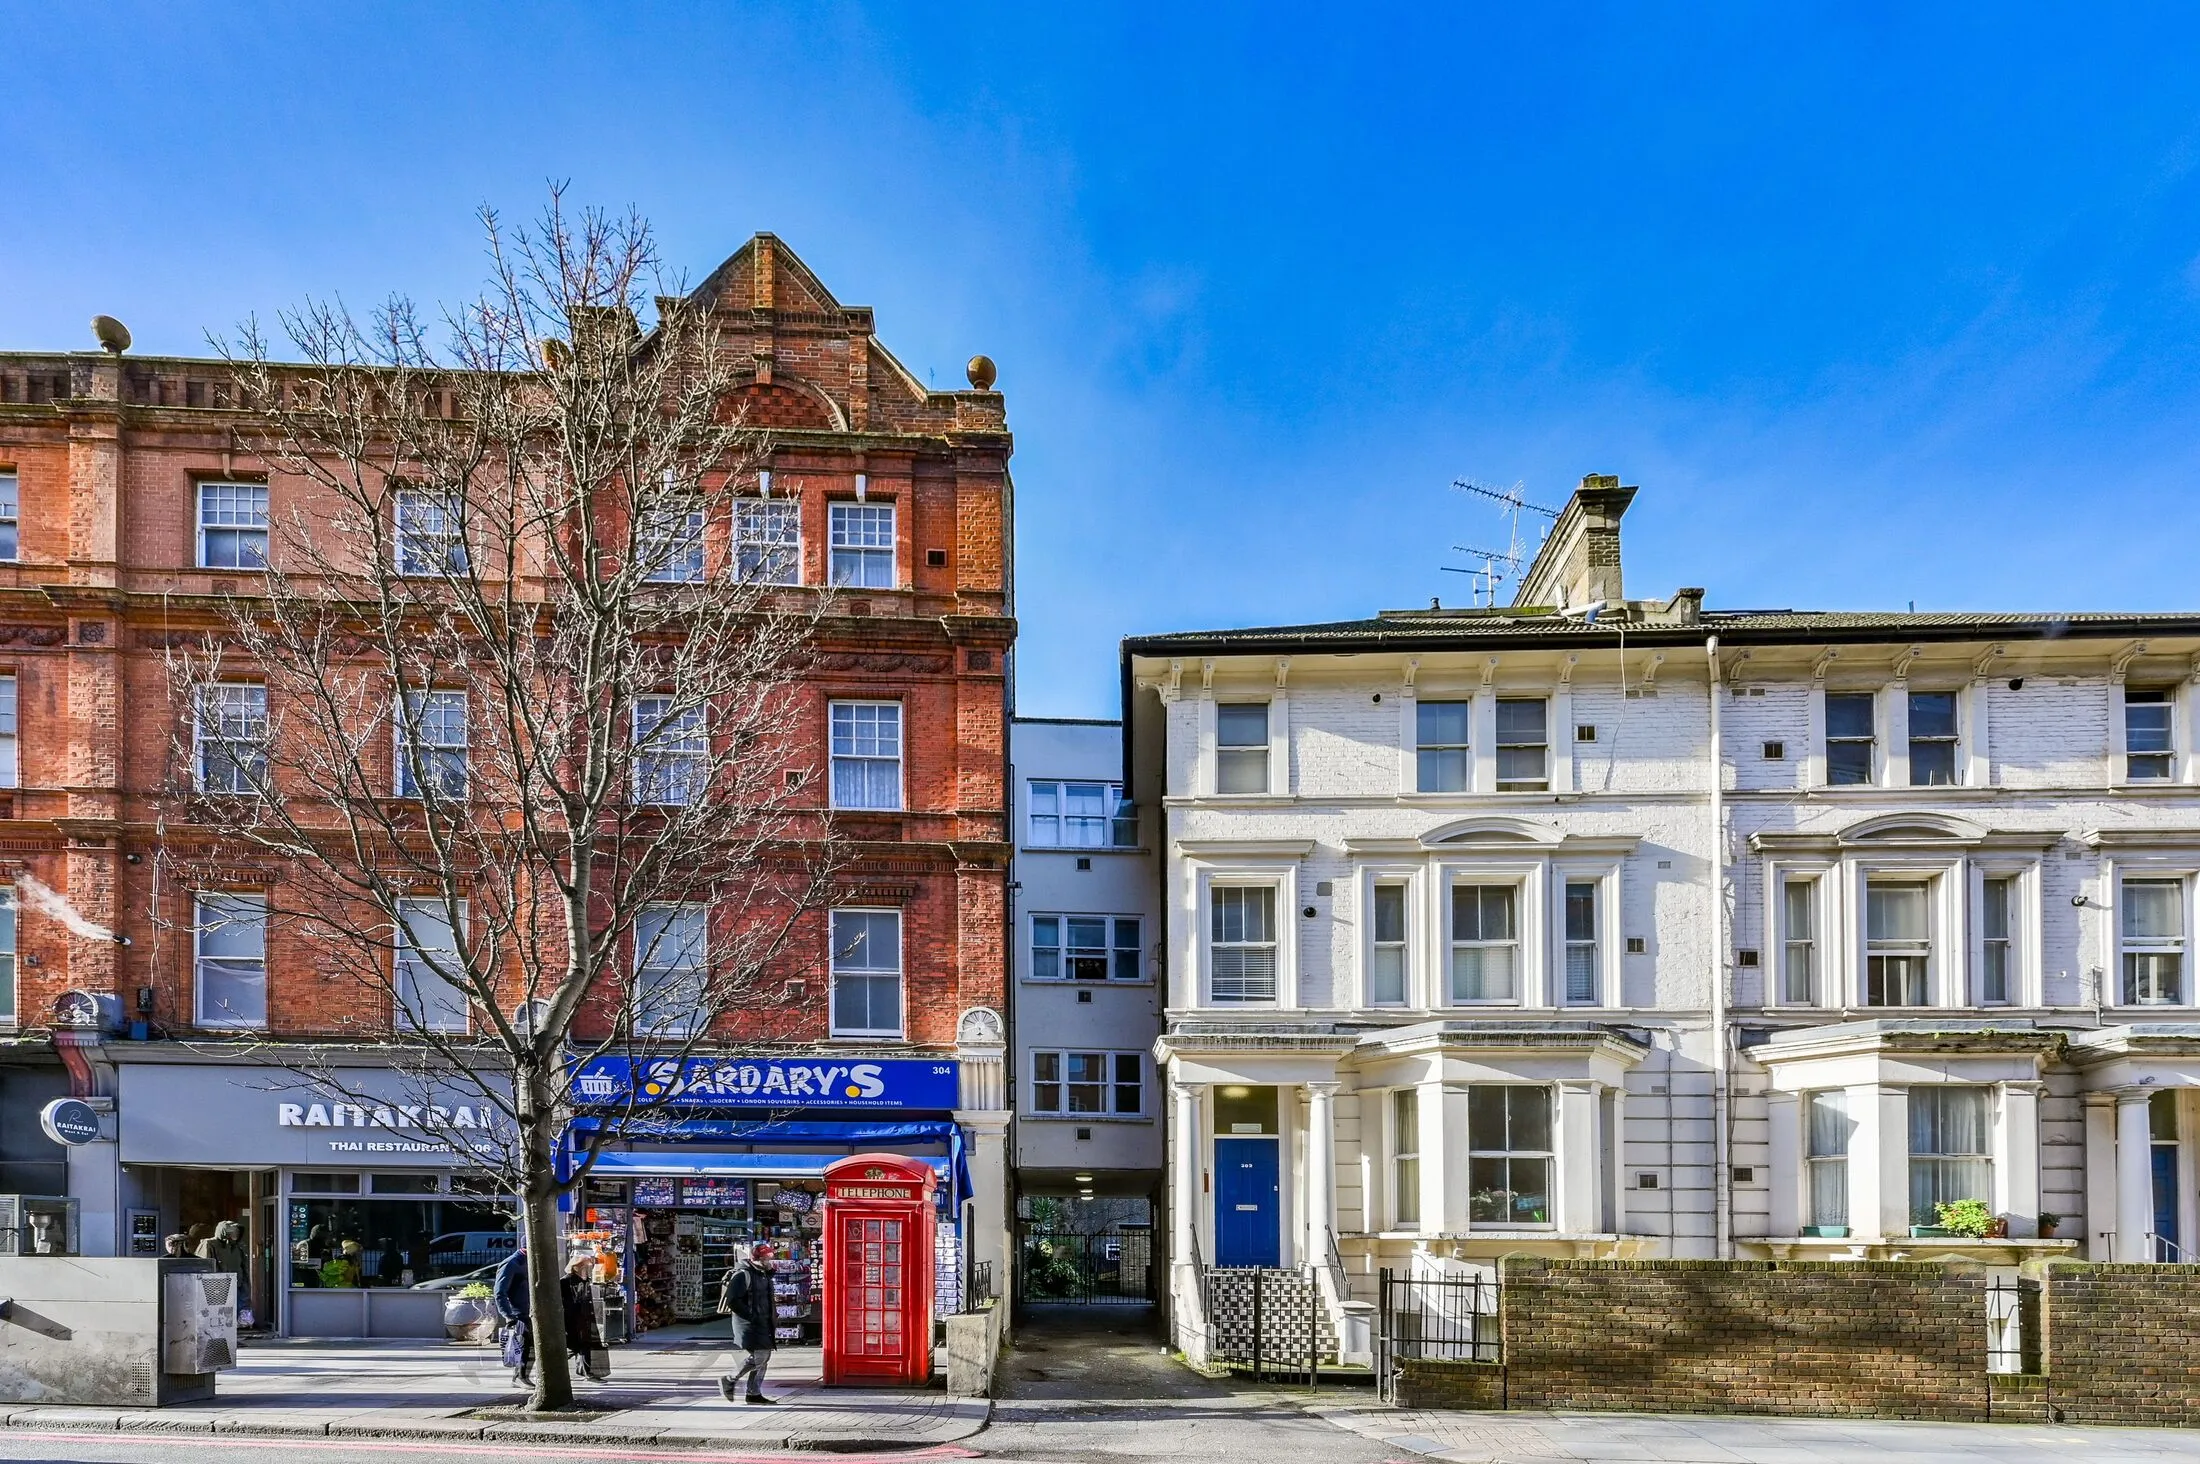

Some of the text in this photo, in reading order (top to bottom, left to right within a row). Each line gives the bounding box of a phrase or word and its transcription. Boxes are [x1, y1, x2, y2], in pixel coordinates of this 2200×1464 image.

[932, 1066, 951, 1075] 304
[648, 1061, 884, 1098] SARDARY'S
[279, 1103, 492, 1129] RAITAKRAI
[57, 1122, 96, 1132] RAITAKRAI
[329, 1141, 363, 1152] THAI
[841, 1187, 910, 1199] TELEPHONE
